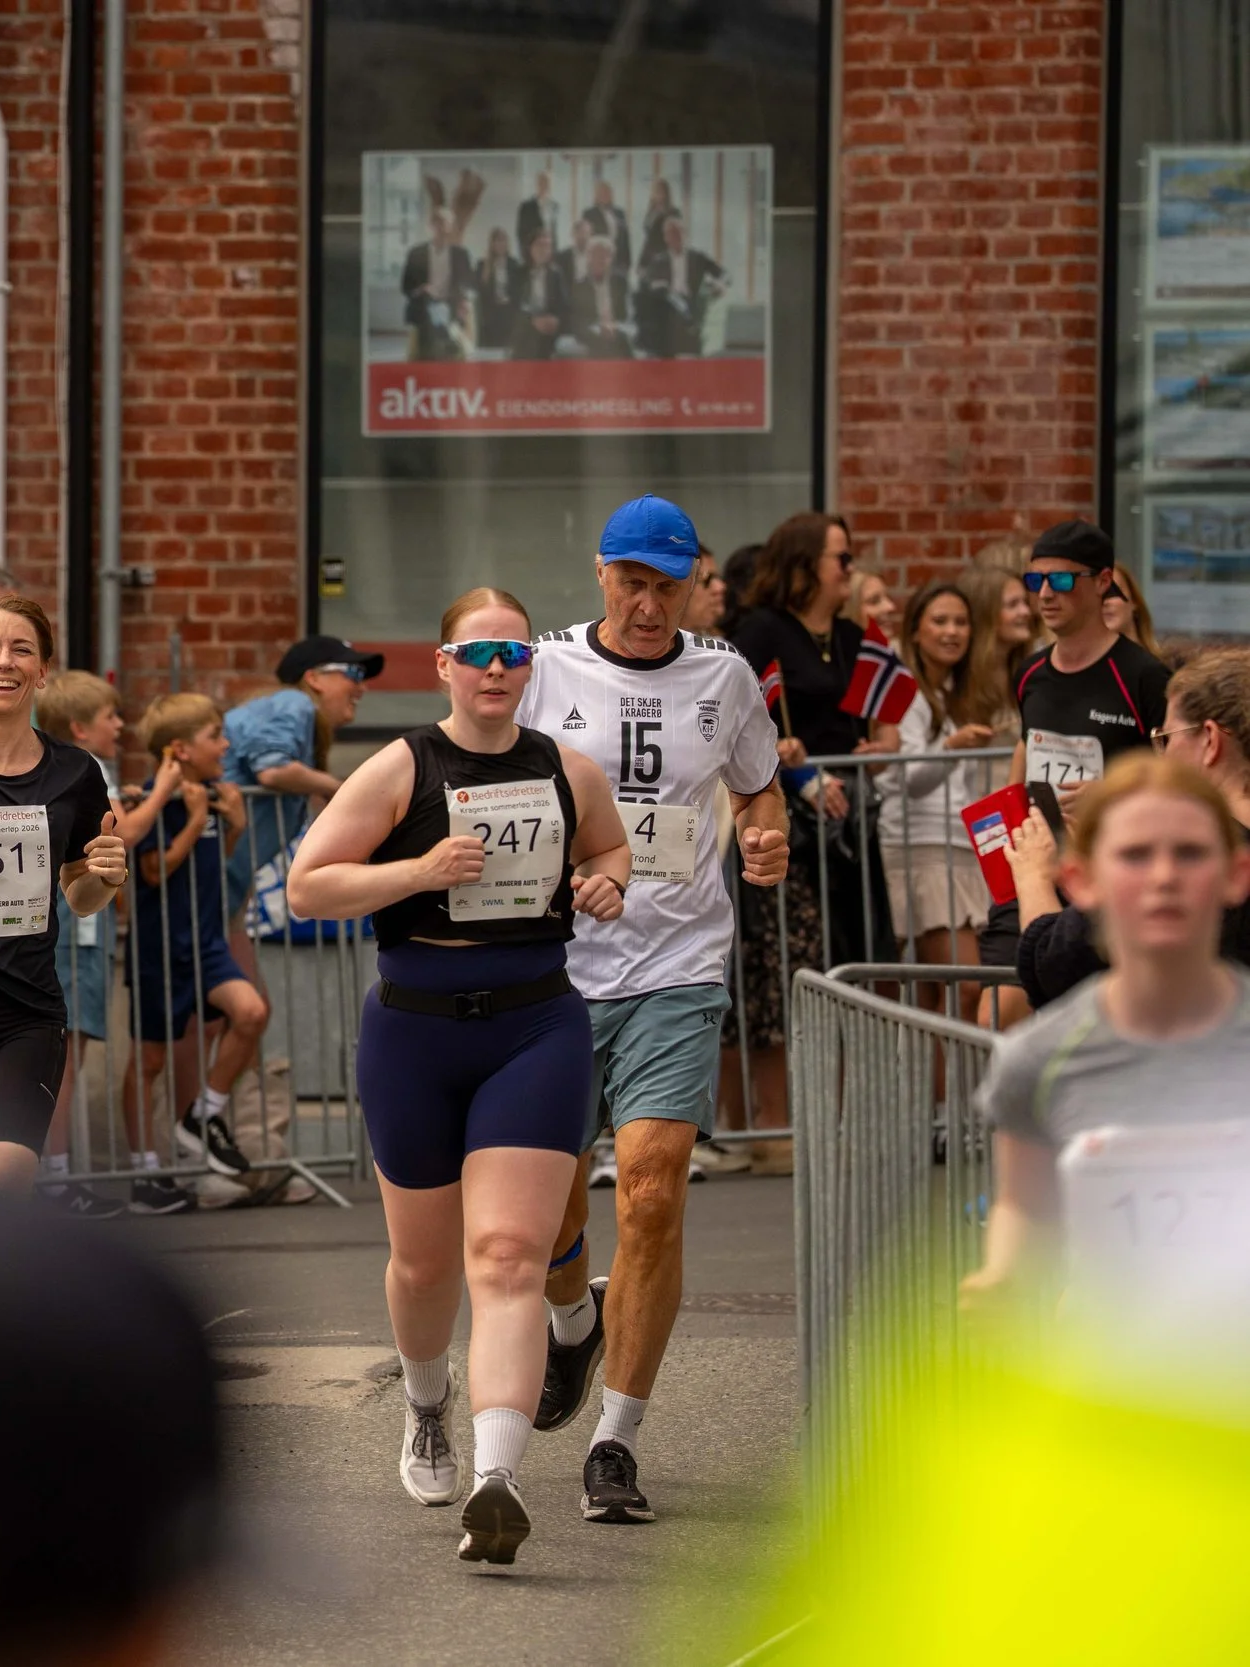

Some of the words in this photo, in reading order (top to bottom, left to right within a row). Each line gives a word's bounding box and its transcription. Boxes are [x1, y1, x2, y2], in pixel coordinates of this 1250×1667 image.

[496, 397, 673, 418] EIENDOMSMEGLING
[620, 697, 635, 706] DET
[638, 698, 662, 708] SKJER
[620, 708, 623, 717] I
[625, 708, 662, 718] KRAGERØ
[562, 722, 587, 730] SELECT
[1118, 714, 1136, 727] Auto
[620, 722, 662, 784] 15
[1041, 761, 1084, 784] 171
[471, 786, 545, 801] Bedriftsidretten
[460, 805, 488, 815] Kragerø
[490, 802, 531, 812] sommerløp
[21, 824, 39, 832] 2026
[635, 812, 656, 844] 4
[685, 828, 694, 842] KM
[473, 818, 542, 855] 247
[551, 830, 559, 844] KM
[37, 854, 45, 868] KM
[631, 869, 653, 877] RAGERØ
